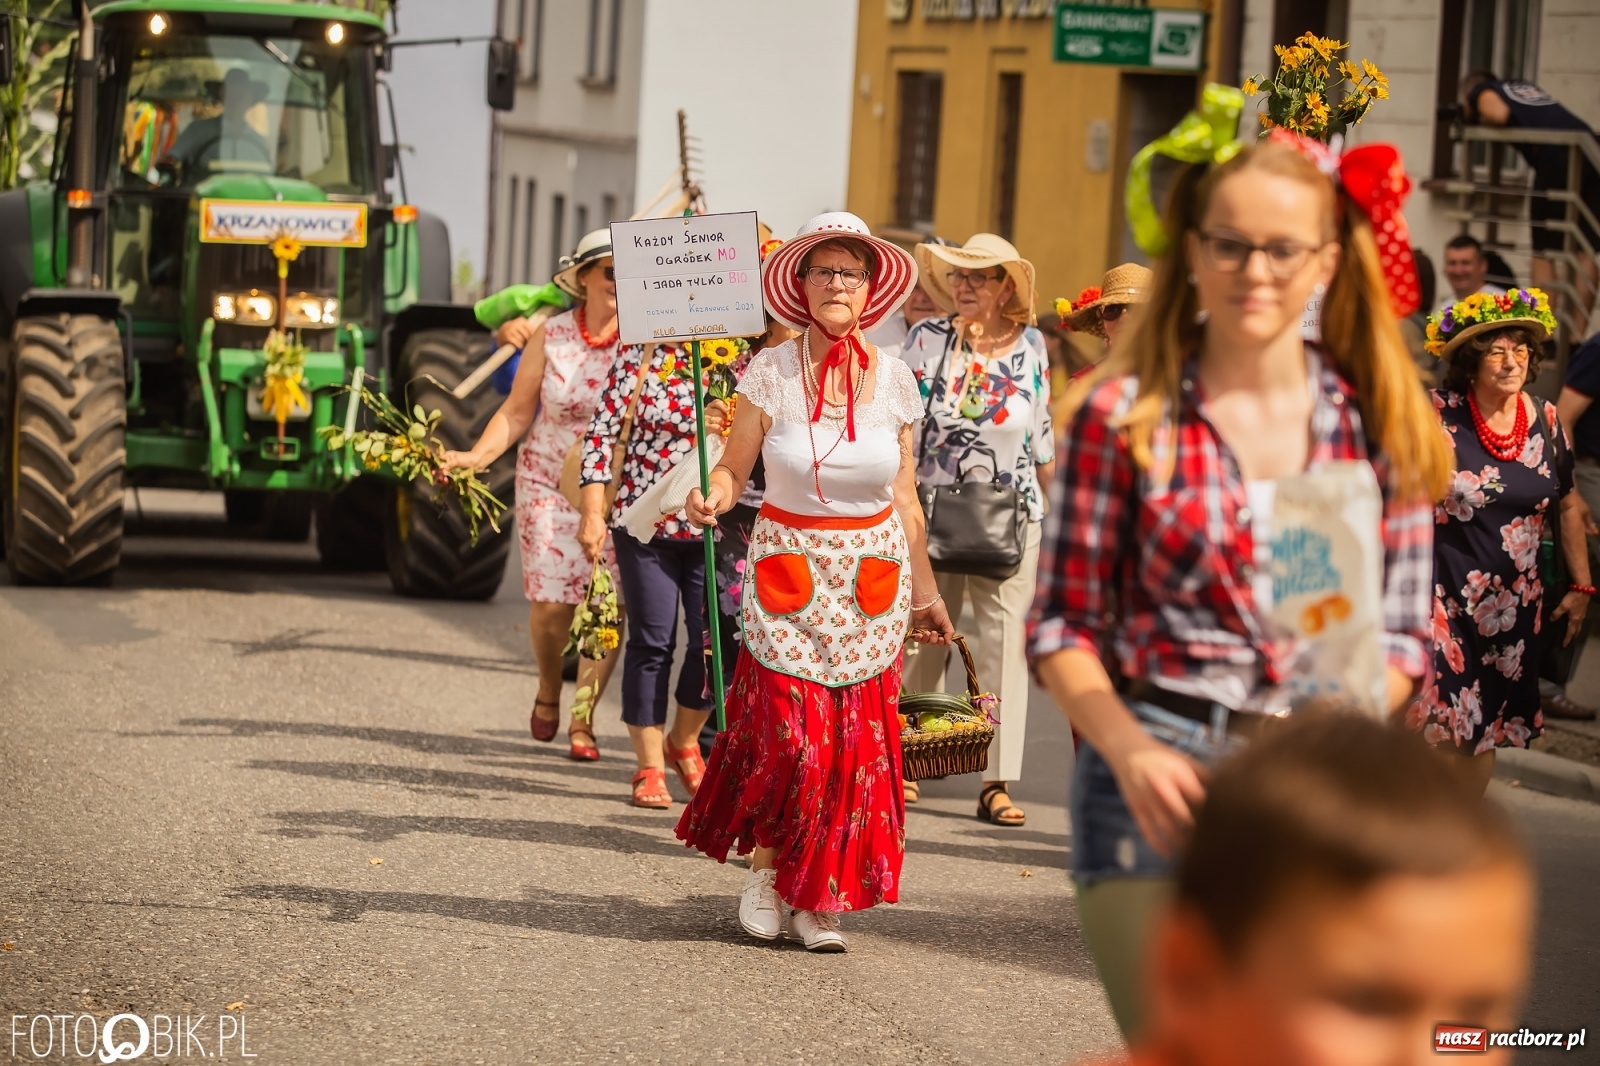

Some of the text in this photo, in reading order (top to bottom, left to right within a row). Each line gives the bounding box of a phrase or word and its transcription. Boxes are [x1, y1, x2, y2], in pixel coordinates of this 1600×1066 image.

[217, 213, 353, 232] KRZANOWICE
[634, 230, 725, 248] KAŻDY SENIOR
[655, 247, 736, 266] OGRÓDEK MO
[643, 280, 647, 290] I
[686, 274, 723, 287] TYLKO
[728, 271, 748, 284] BIO
[735, 301, 755, 311] 2021
[653, 326, 676, 337] KLUB
[1302, 319, 1321, 328] 202
